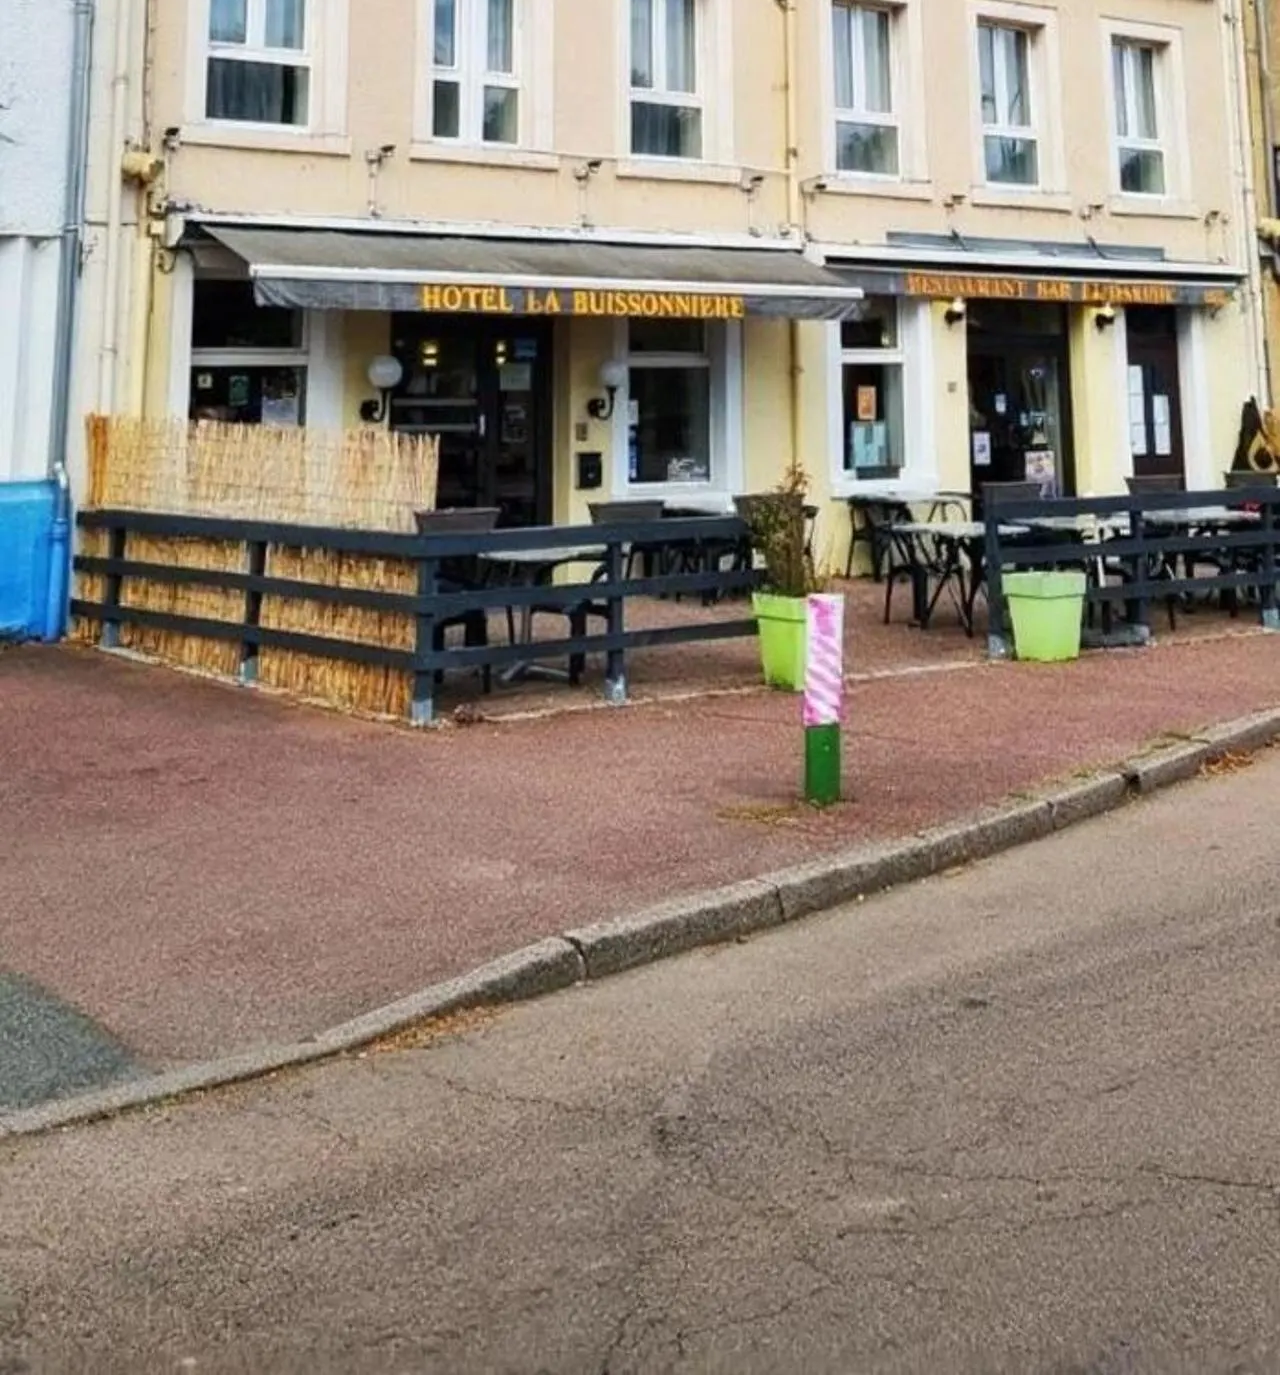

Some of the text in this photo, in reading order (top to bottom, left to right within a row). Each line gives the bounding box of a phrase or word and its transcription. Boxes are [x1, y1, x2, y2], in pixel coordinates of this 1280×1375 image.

[421, 284, 745, 318] HOTEL LA BUISSONNIERE
